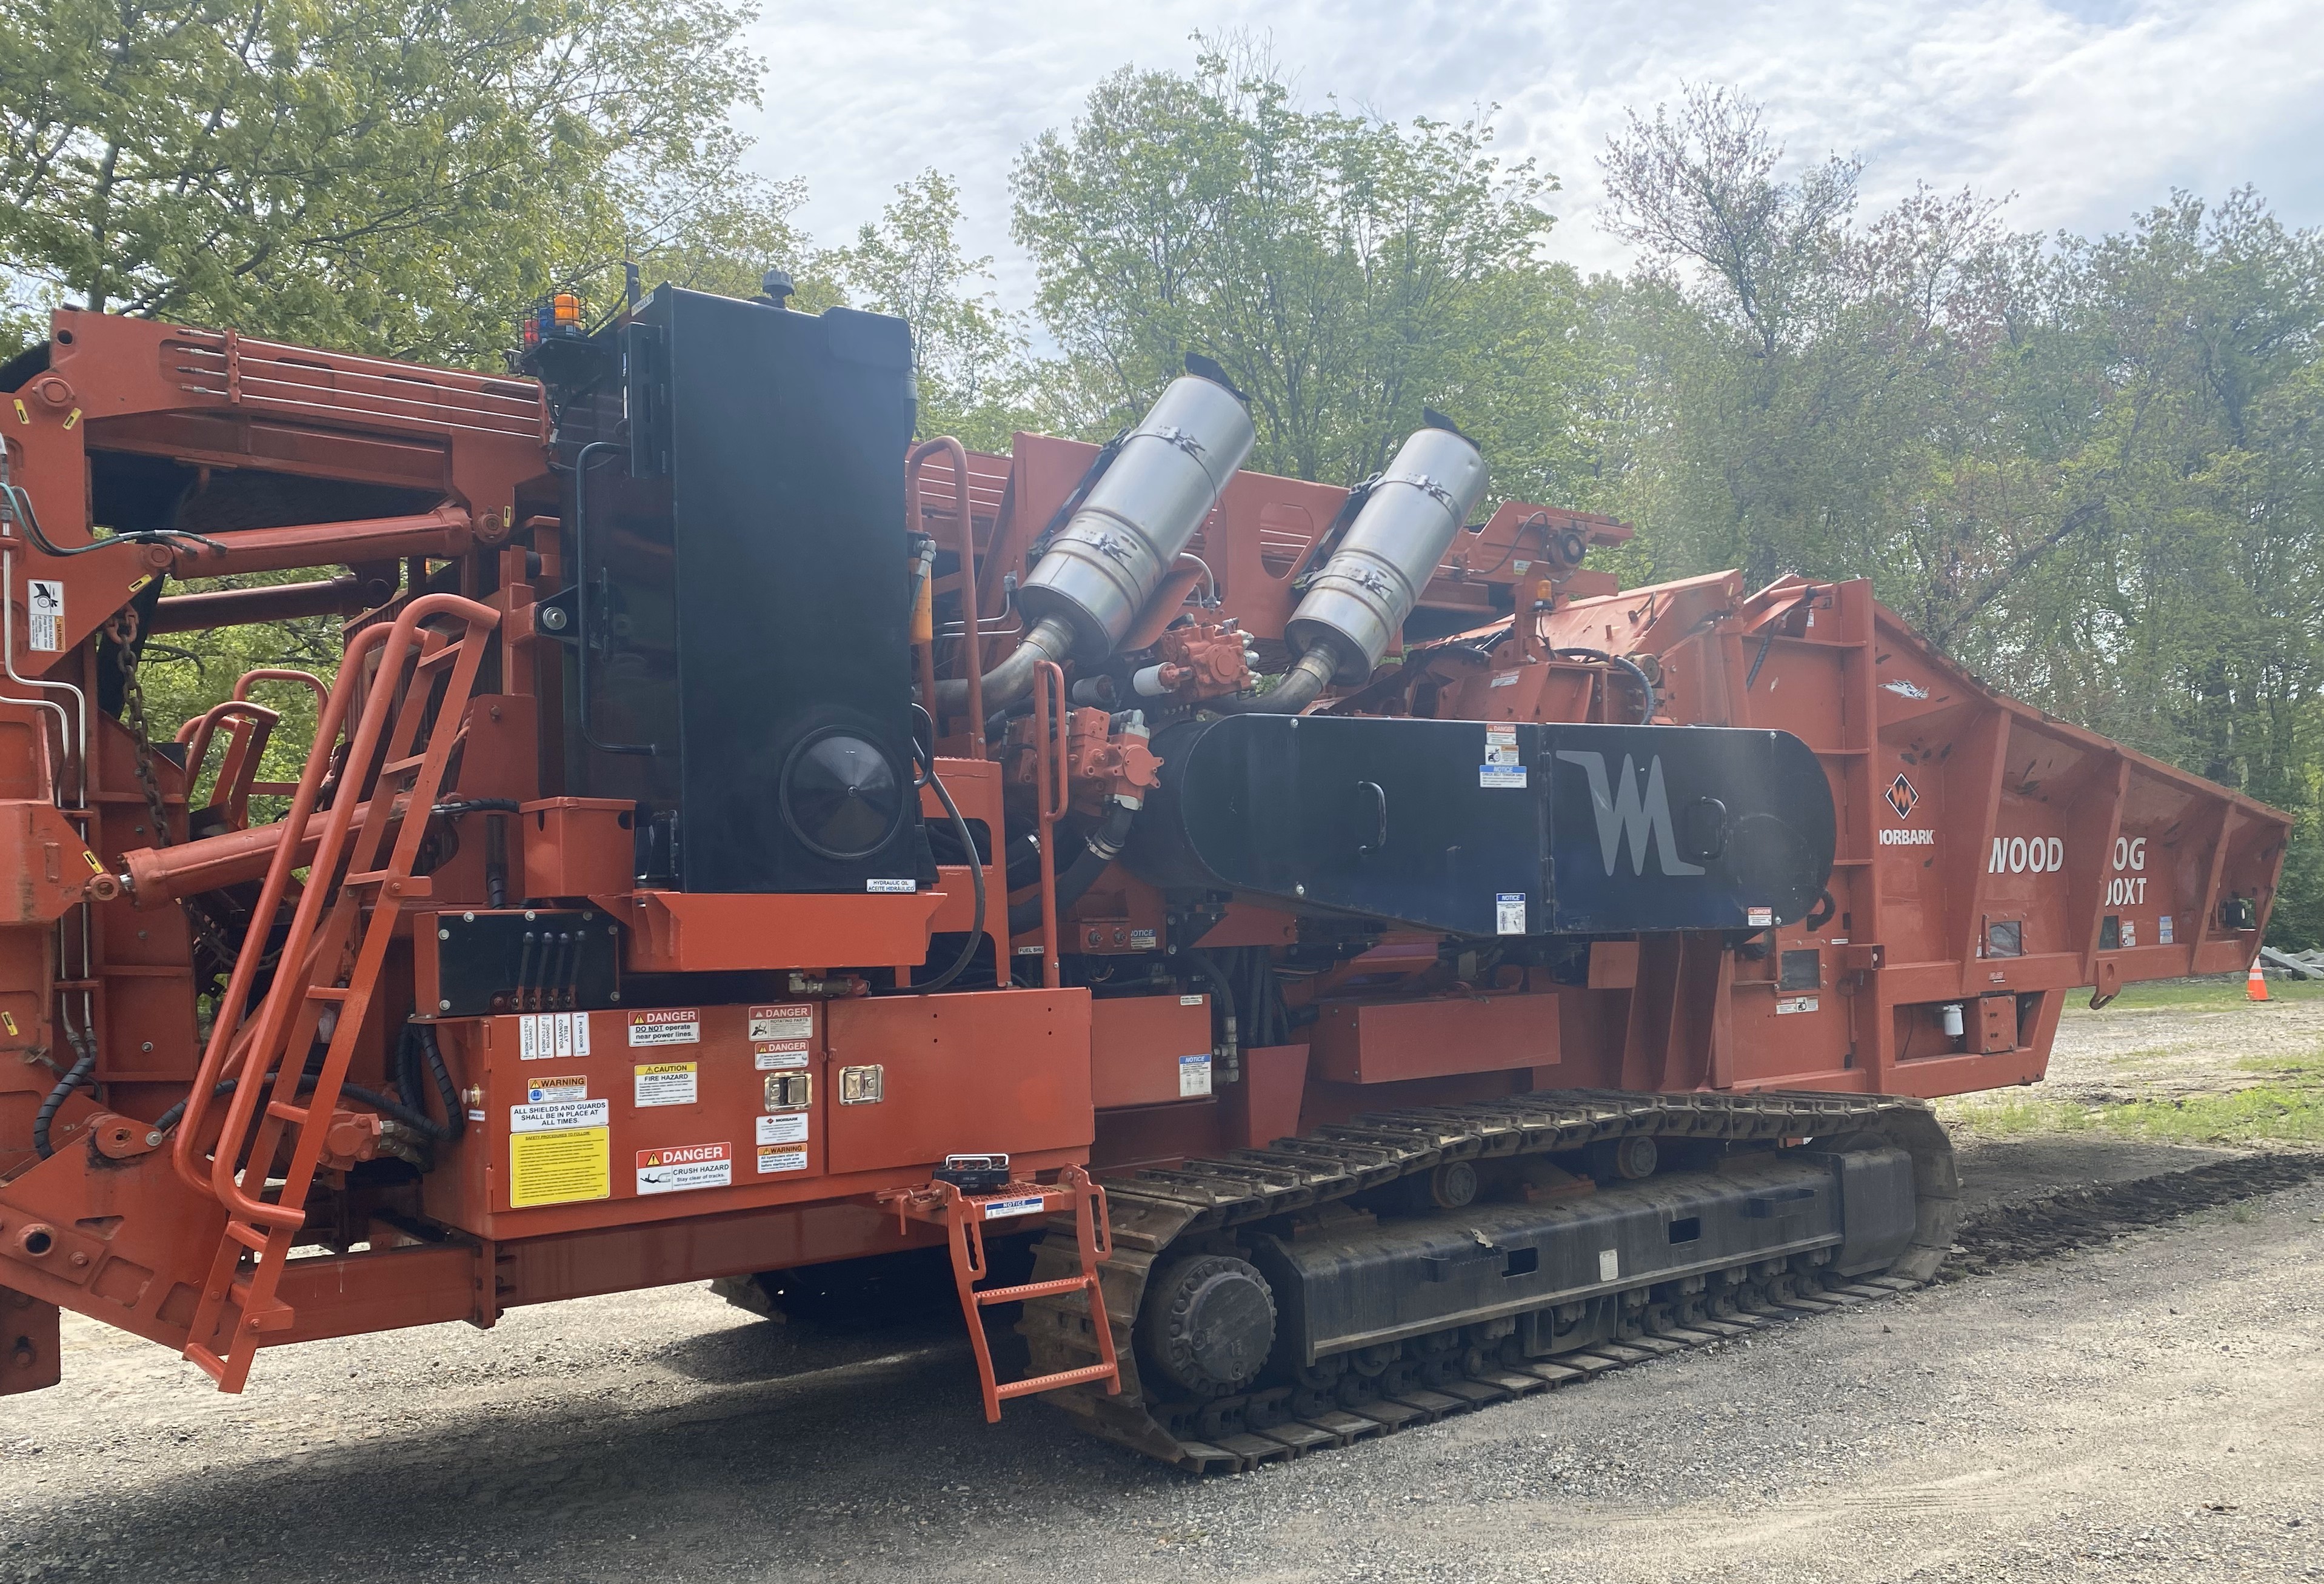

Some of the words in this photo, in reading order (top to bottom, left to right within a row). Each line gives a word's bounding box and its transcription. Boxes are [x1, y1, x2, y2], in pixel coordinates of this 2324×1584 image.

[2113, 837, 2147, 871] OG
[647, 1011, 695, 1023] DANGER
[766, 1008, 808, 1017] DANGER
[769, 1042, 806, 1052] DANGER
[541, 1078, 584, 1087] WARNING
[663, 1146, 723, 1164] DANGER
[700, 1164, 729, 1172] HAZARD
